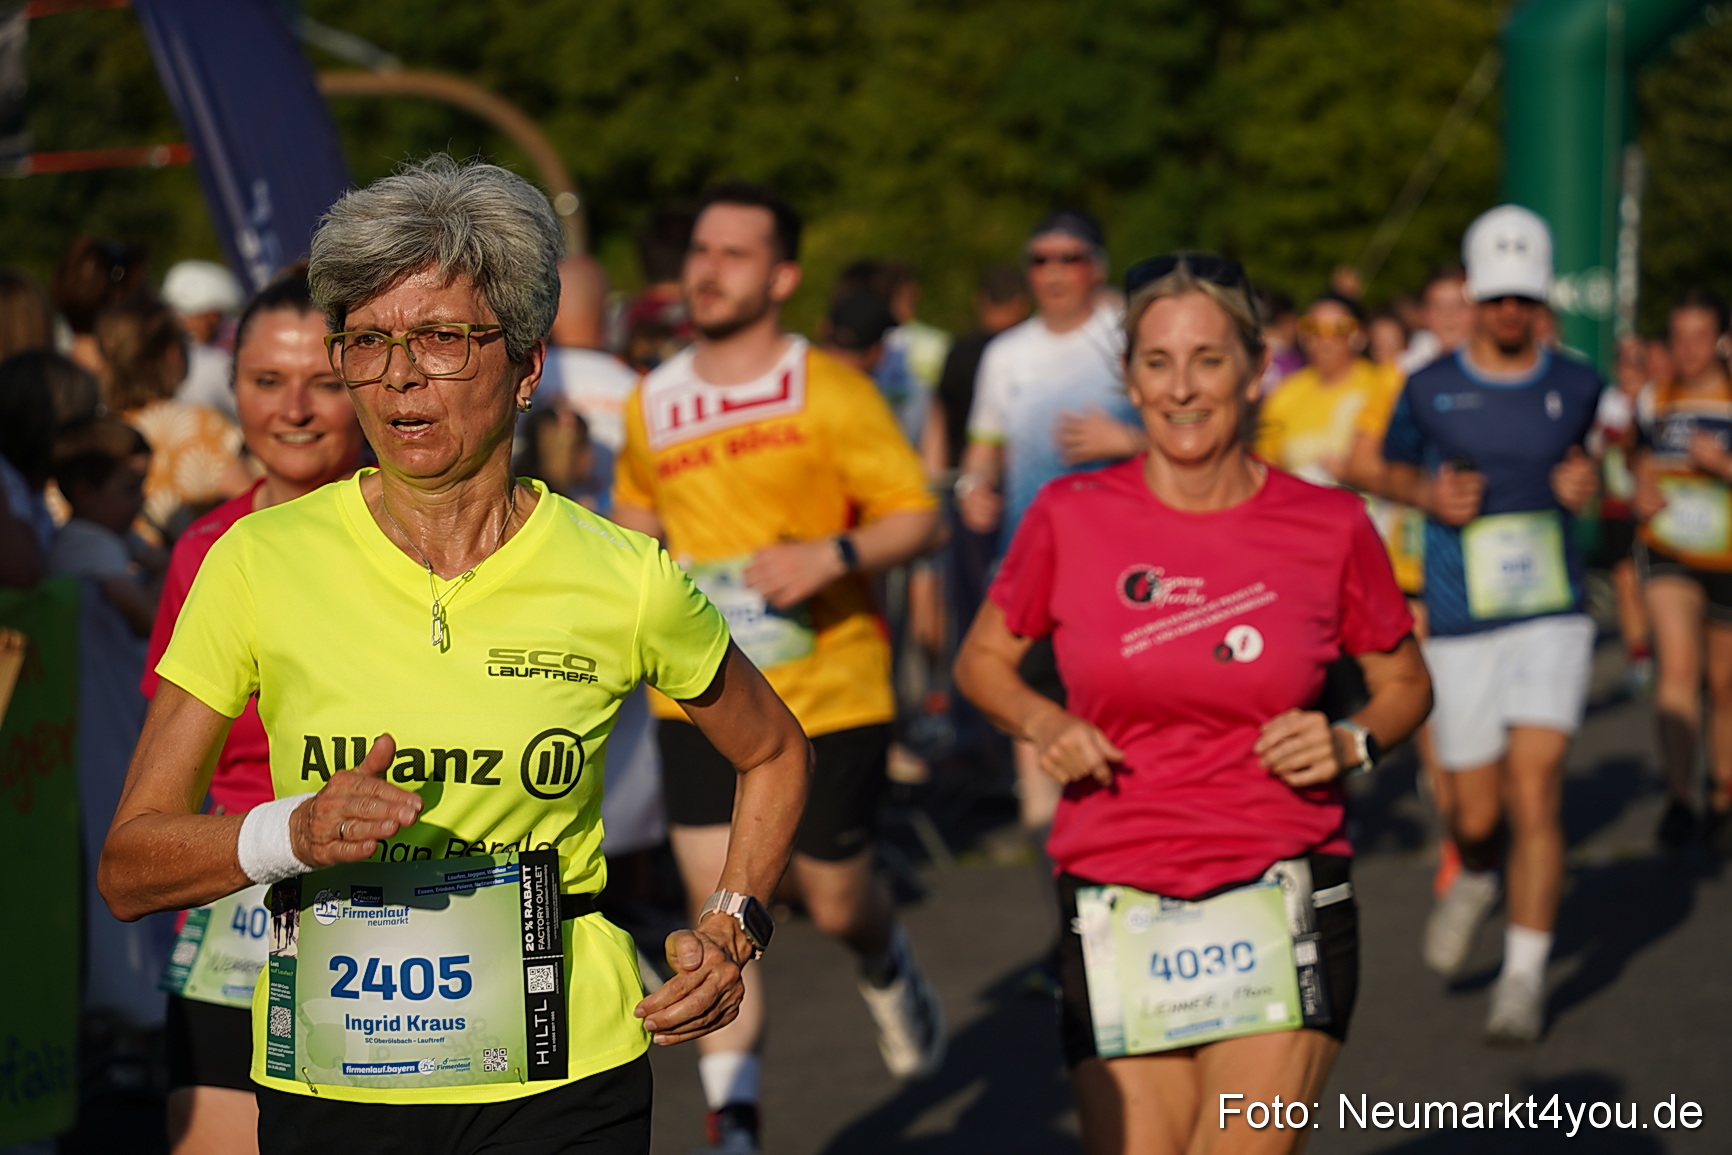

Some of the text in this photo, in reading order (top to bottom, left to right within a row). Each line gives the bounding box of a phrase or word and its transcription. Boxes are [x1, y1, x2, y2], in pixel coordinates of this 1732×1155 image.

[484, 648, 597, 673] SCO
[301, 734, 504, 786] Allanz
[447, 873, 467, 881] Laufen,
[435, 885, 456, 893] Trinken,
[342, 905, 410, 918] Firmenlauf
[522, 864, 535, 951] 20 % RABATT
[535, 864, 545, 950] FACTORY OUTLET
[367, 917, 409, 926] neumarkt
[329, 954, 473, 1001] 2405
[345, 1013, 466, 1035] Ingrid Kraus
[534, 999, 549, 1065] HILTL
[345, 1065, 415, 1074] firmenlauf.bayern
[436, 1061, 471, 1070] Firmenlauf
